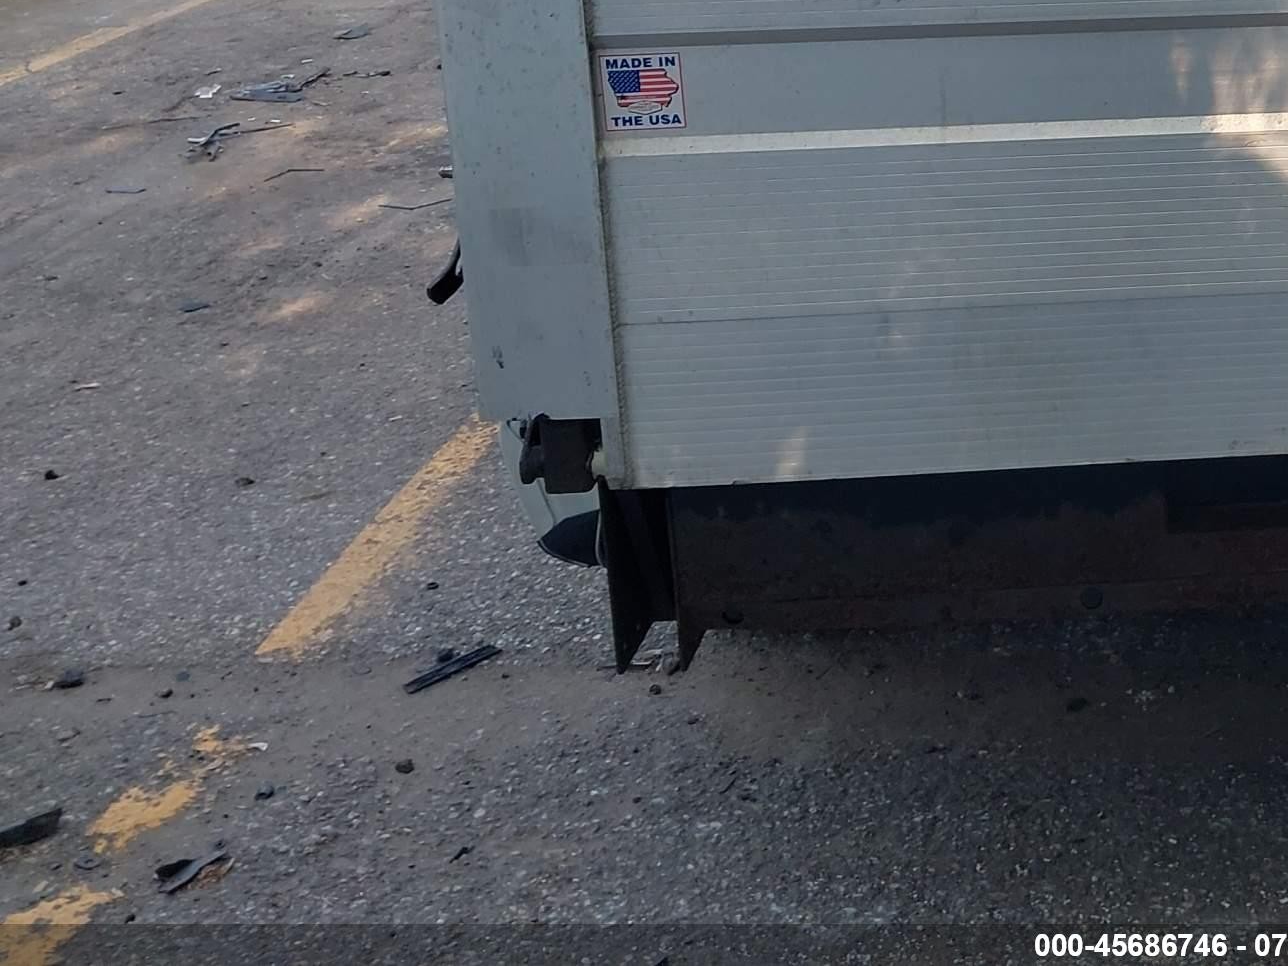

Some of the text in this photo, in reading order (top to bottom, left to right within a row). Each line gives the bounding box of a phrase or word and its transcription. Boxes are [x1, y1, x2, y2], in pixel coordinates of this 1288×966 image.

[605, 56, 676, 70] MADE IN
[611, 114, 682, 127] THE USA
